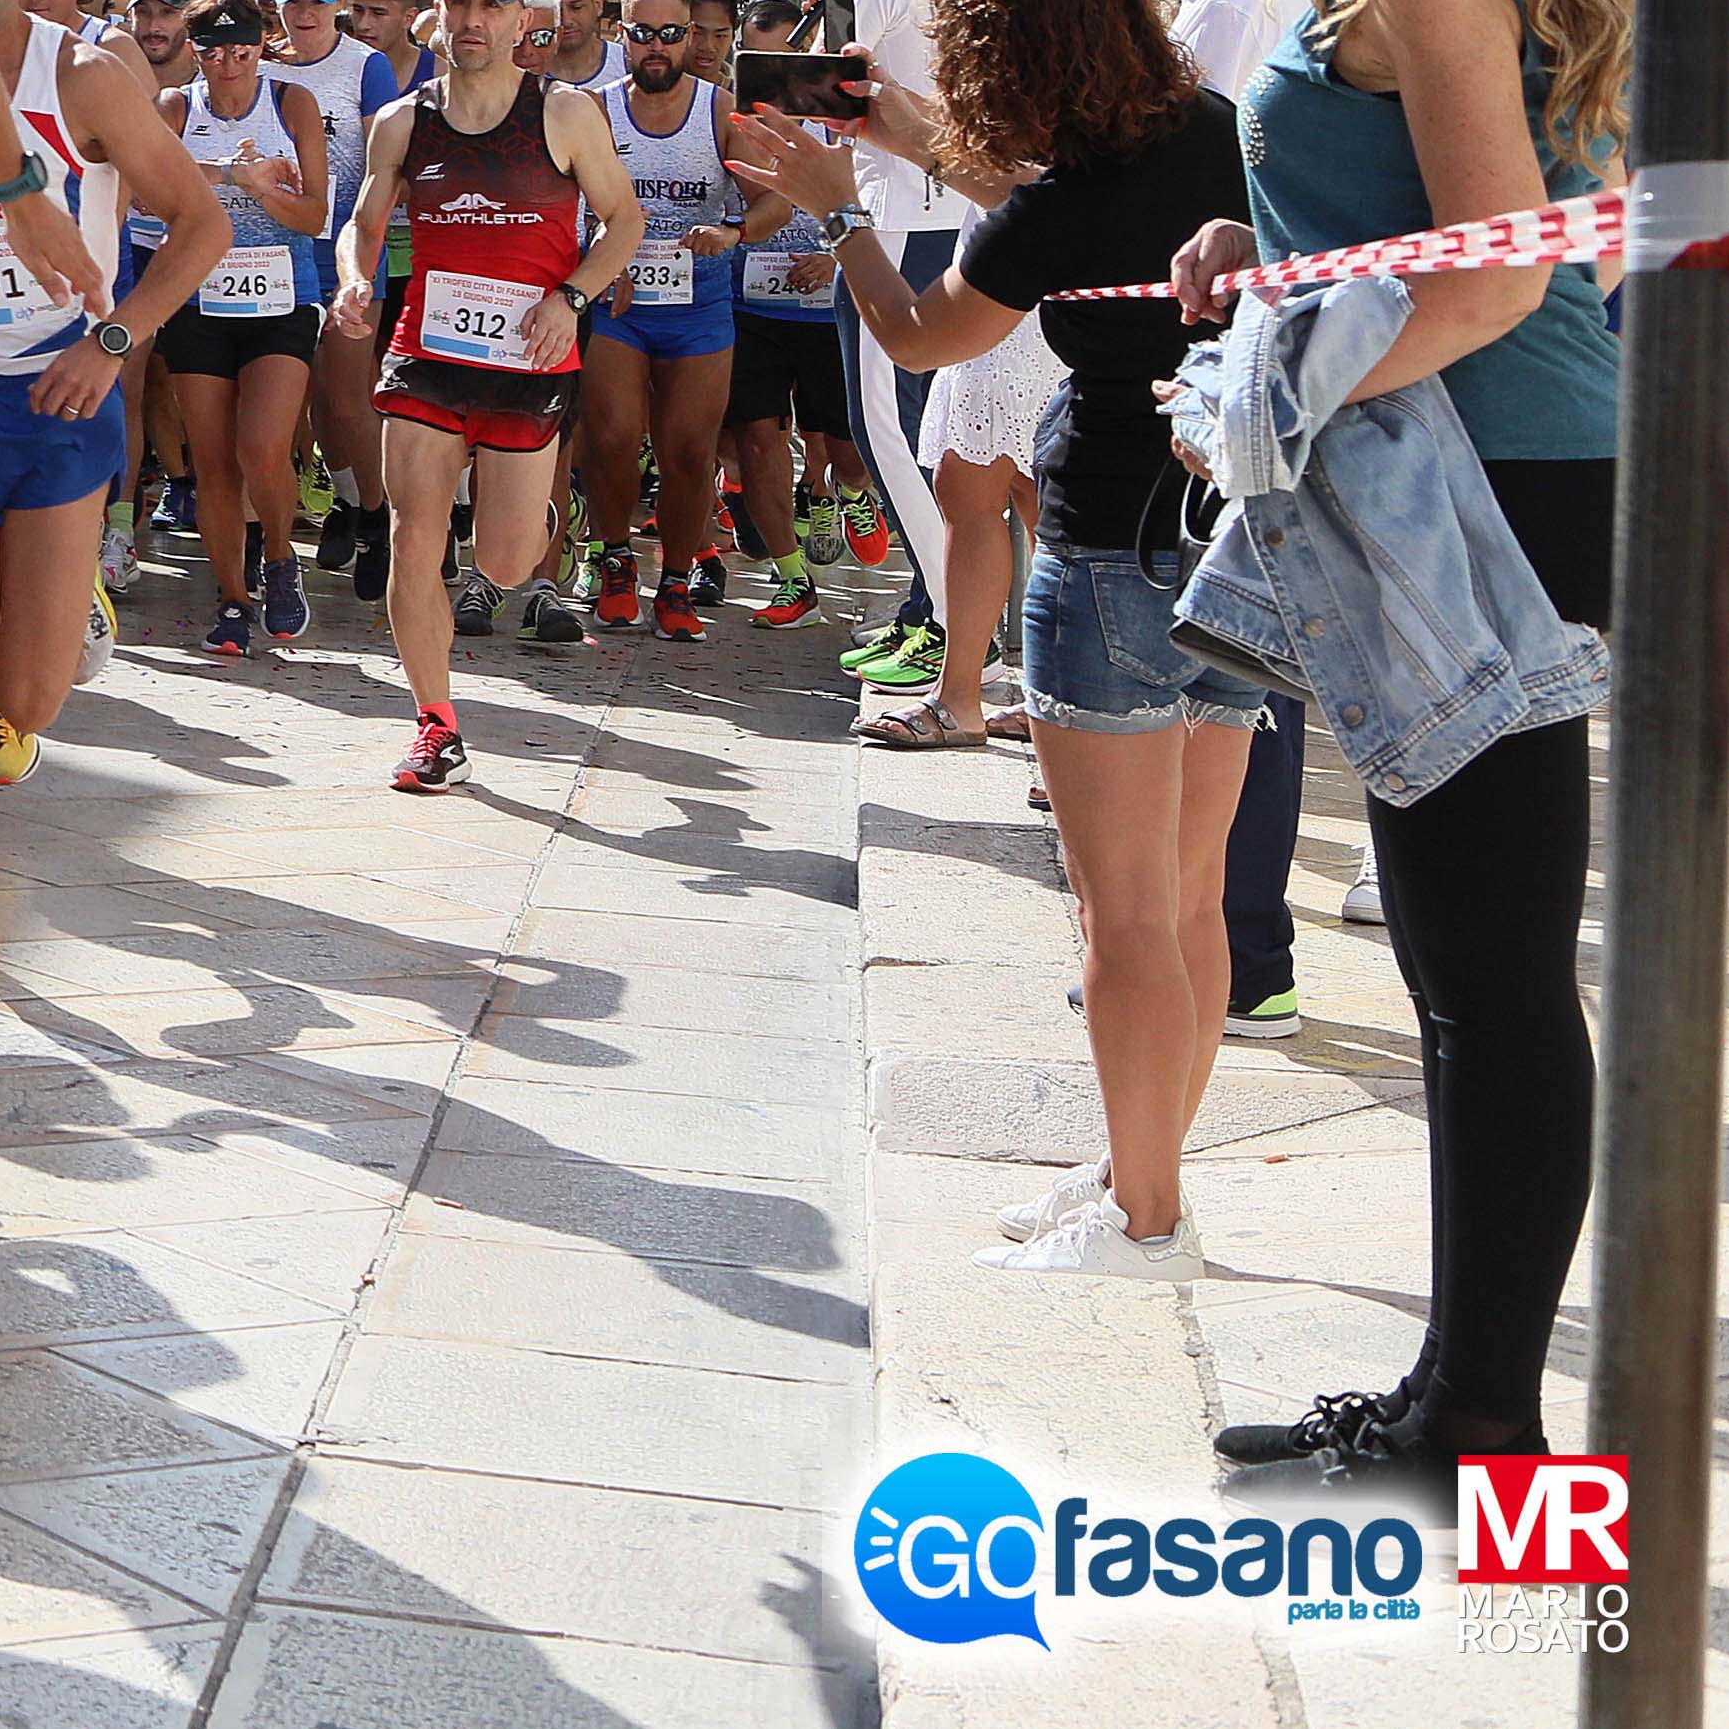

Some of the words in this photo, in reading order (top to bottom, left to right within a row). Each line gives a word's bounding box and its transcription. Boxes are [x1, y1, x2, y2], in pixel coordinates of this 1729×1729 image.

[223, 274, 267, 297] 246
[629, 265, 671, 285] 233
[442, 277, 472, 289] TROFEO
[473, 281, 495, 292] CITTÀ
[497, 286, 505, 294] DI
[506, 289, 537, 299] FASANO
[454, 307, 507, 340] 312
